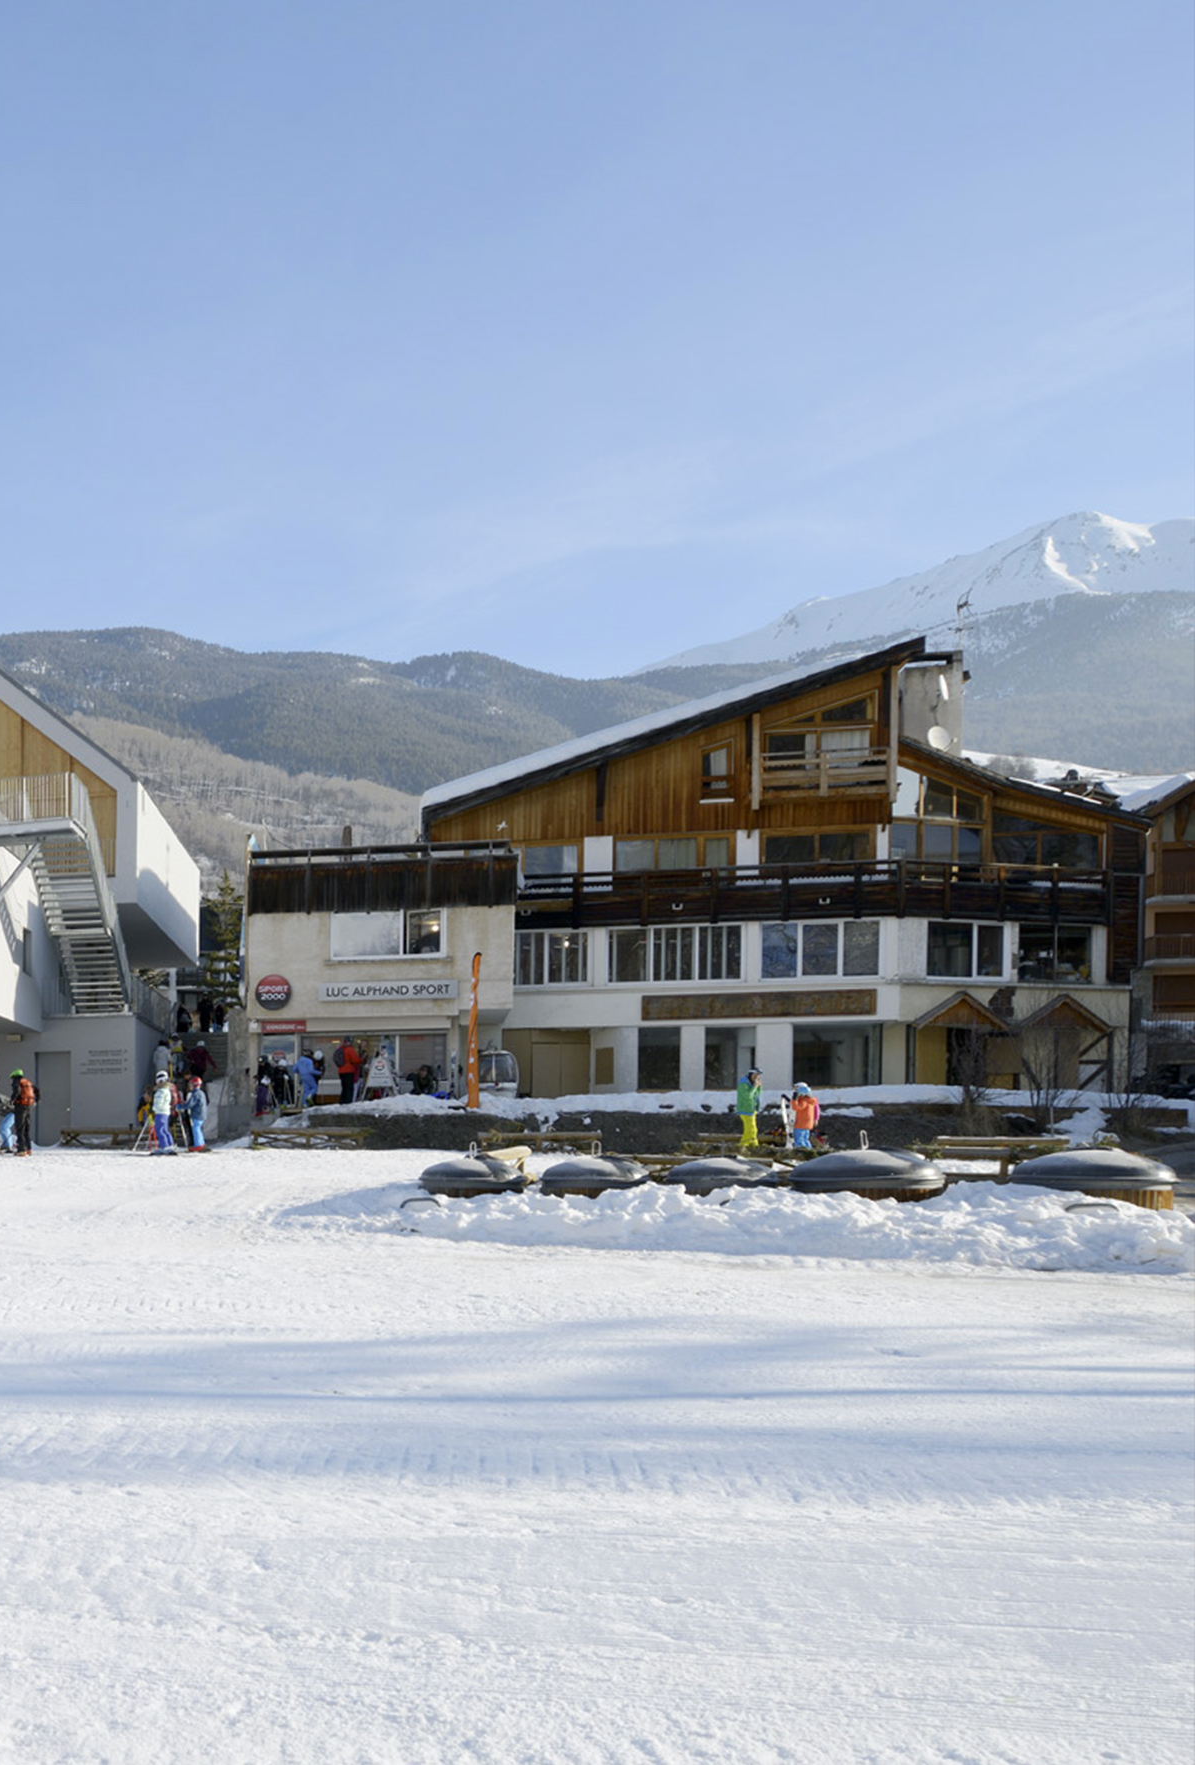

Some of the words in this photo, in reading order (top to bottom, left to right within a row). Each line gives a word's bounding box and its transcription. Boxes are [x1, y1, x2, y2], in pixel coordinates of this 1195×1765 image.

[258, 985, 289, 993] SPORT
[326, 987, 349, 997] LUC
[352, 985, 409, 997] ALPHAND
[412, 984, 450, 995] SPORT
